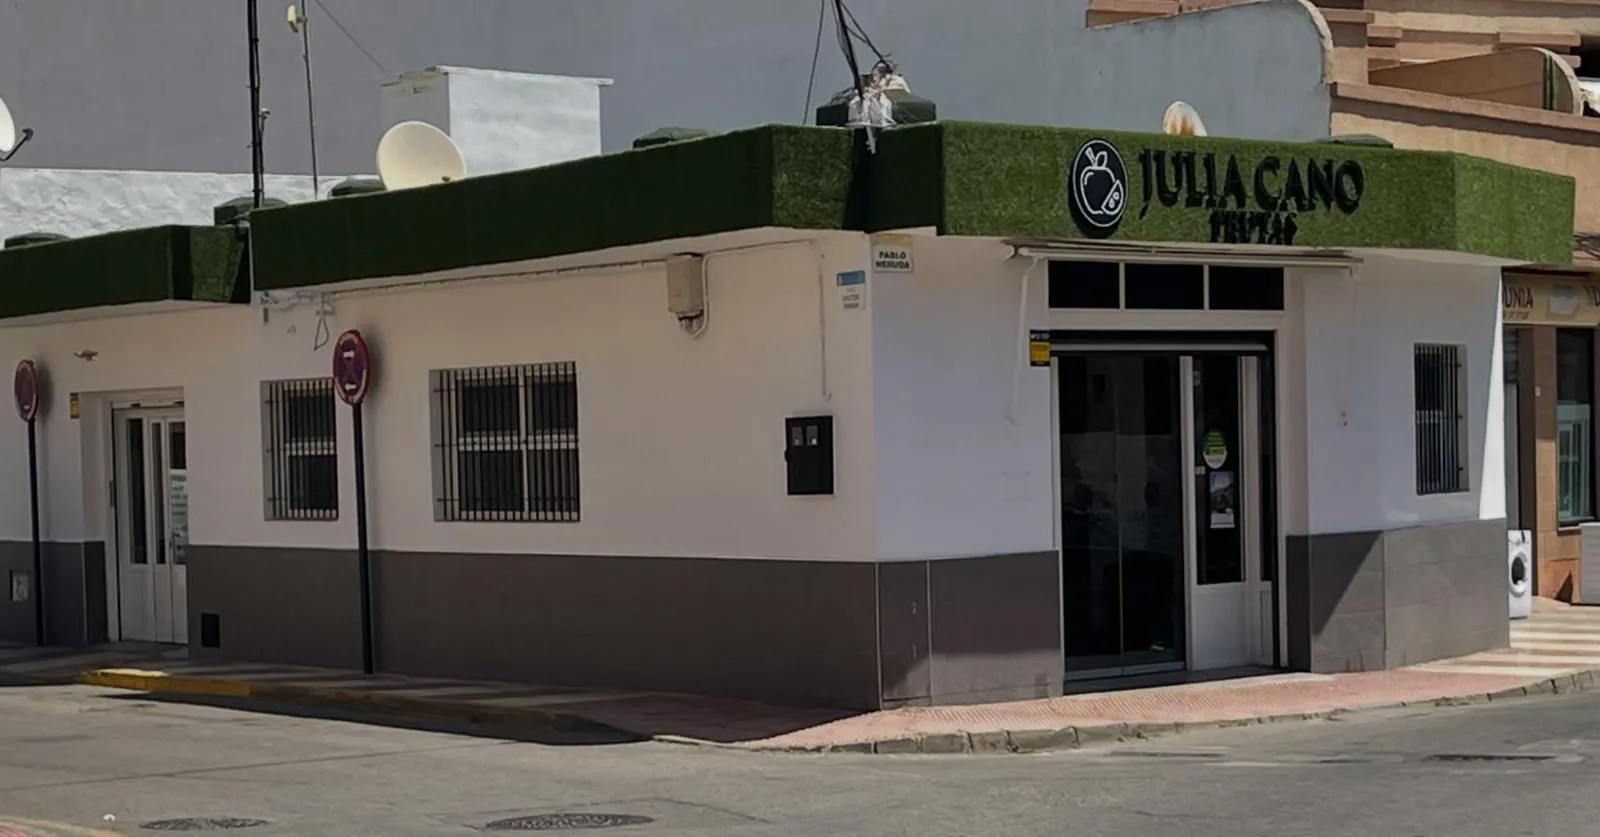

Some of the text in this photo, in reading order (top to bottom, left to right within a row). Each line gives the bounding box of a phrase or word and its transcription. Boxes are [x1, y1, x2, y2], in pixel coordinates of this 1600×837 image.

[1138, 148, 1365, 220] JULIA CANO
[879, 251, 906, 259] PABLO
[875, 260, 910, 269] NERUDA
